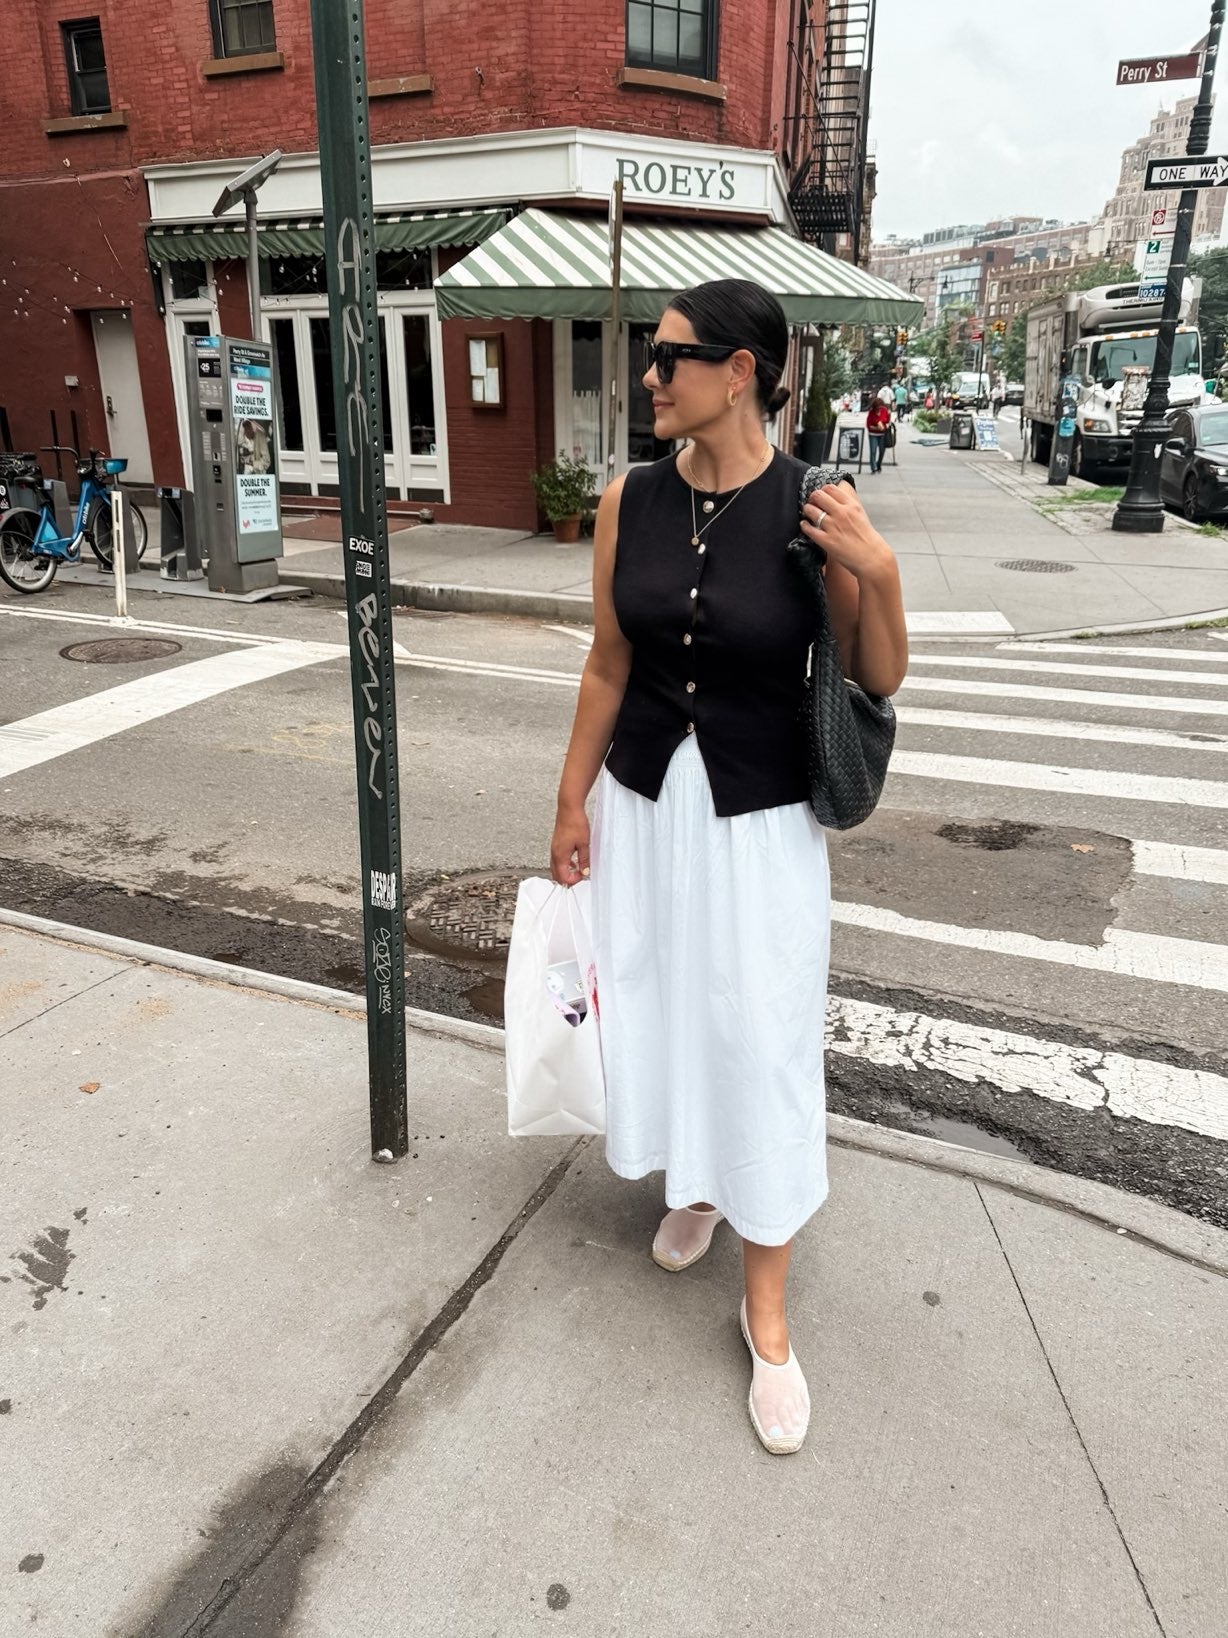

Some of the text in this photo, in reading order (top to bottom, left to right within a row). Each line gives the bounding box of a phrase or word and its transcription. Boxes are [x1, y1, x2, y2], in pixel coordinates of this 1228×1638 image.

[1120, 61, 1168, 83] Perry St
[616, 158, 735, 200] ROEY'S
[1159, 165, 1228, 181] ONE WAY
[1139, 288, 1166, 298] 10287
[235, 395, 266, 406] DOUBLE THE
[234, 405, 269, 417] RIDE SAVINGS.
[240, 478, 270, 488] DOUBLE THE
[244, 488, 267, 497] SUMMER.
[349, 536, 375, 556] EXOE
